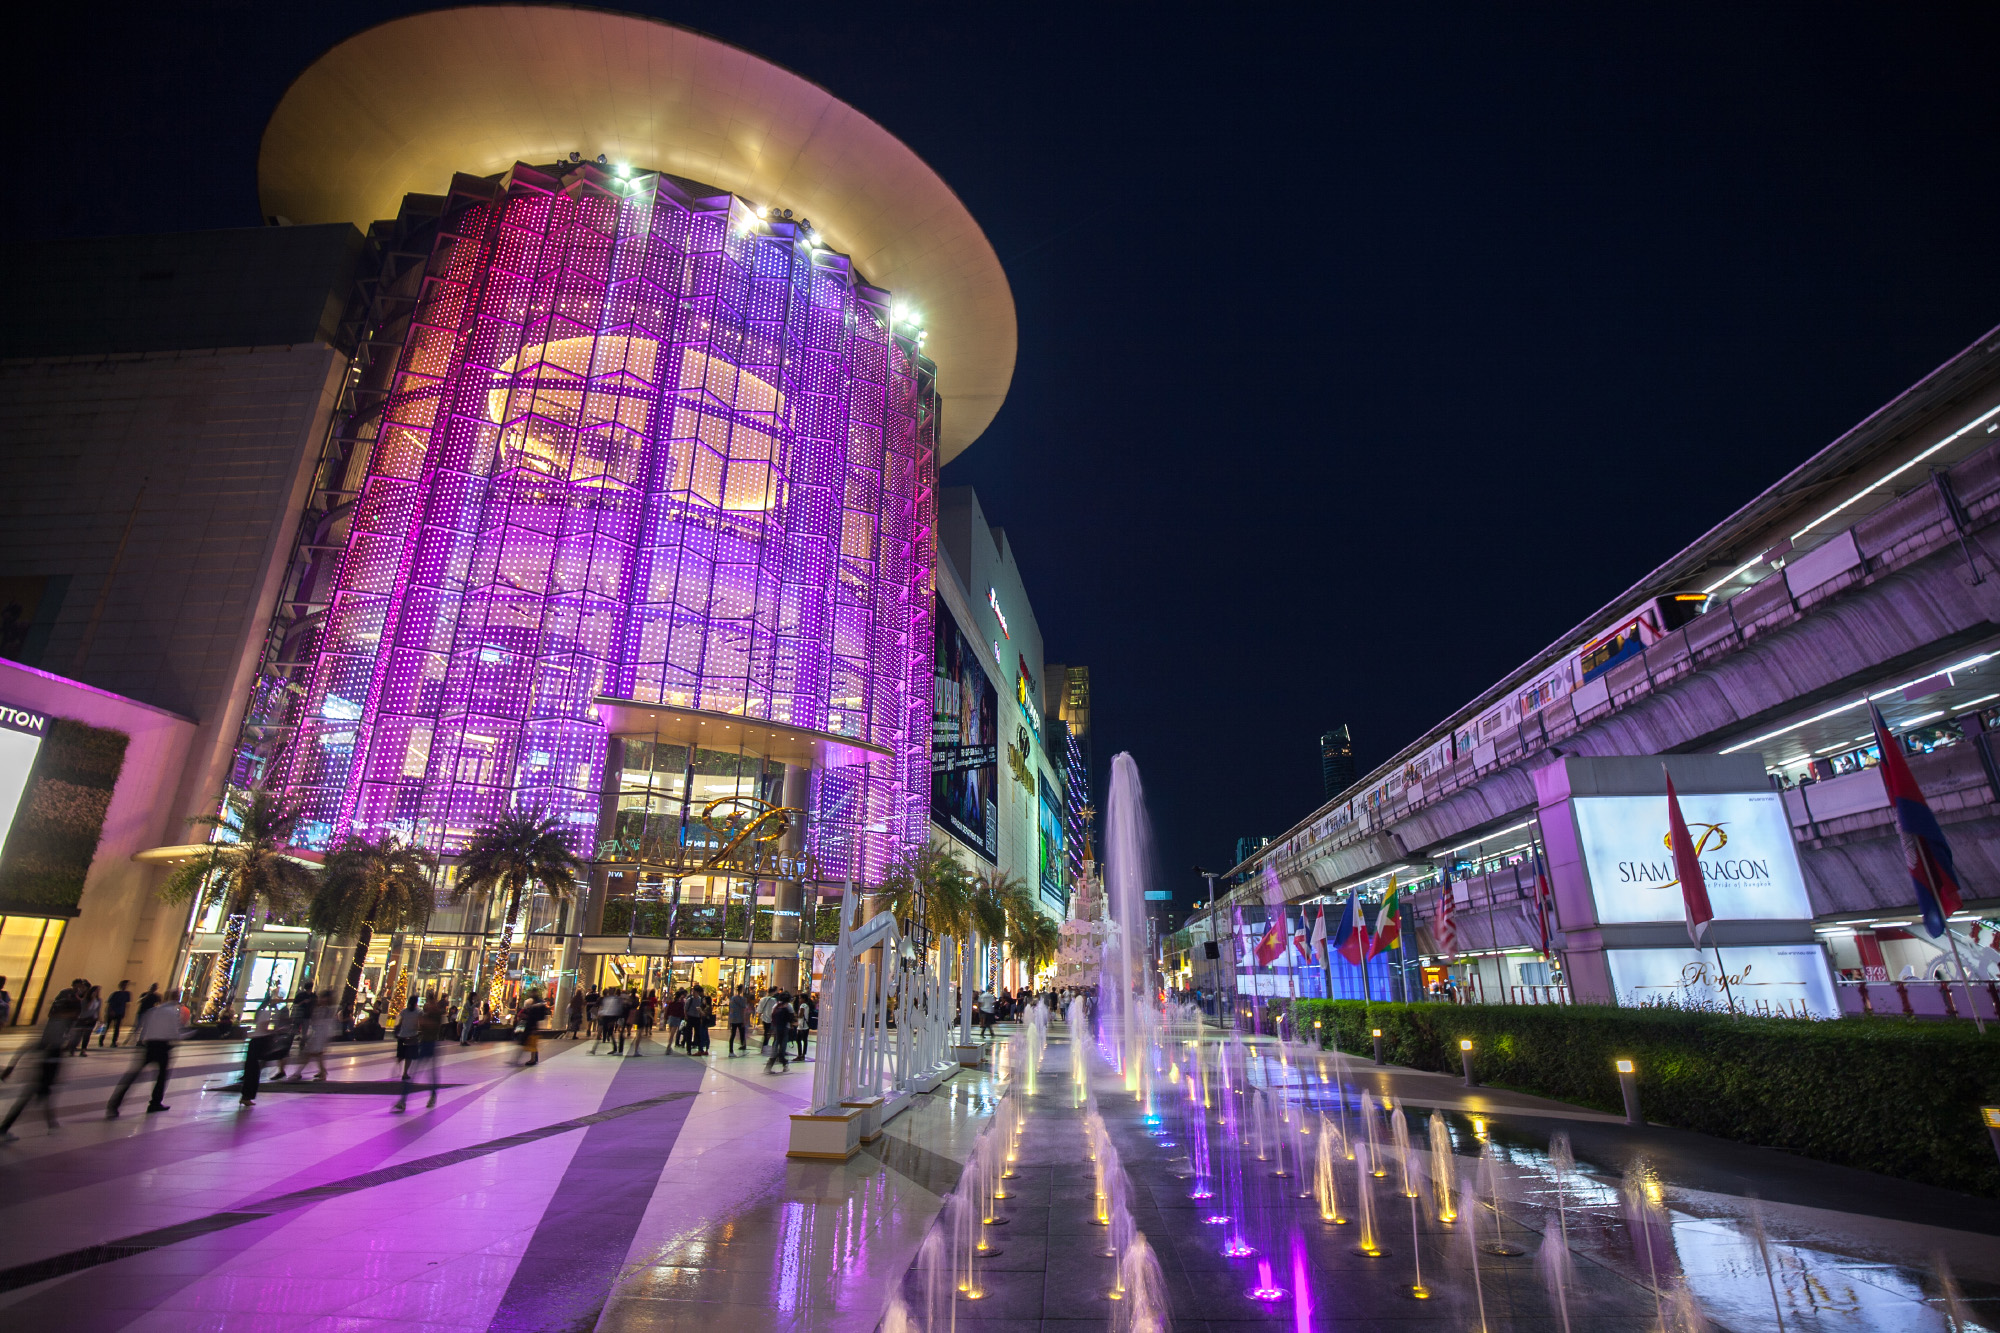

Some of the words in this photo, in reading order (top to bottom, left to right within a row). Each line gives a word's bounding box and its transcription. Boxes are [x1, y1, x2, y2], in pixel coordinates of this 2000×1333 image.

[1521, 679, 1556, 716] MARKET
[621, 833, 694, 868] SIAM
[703, 831, 824, 881] PARAGON
[1618, 861, 1671, 882] SIAM
[1669, 855, 1770, 882] RAGON
[1681, 961, 1752, 993] Royal
